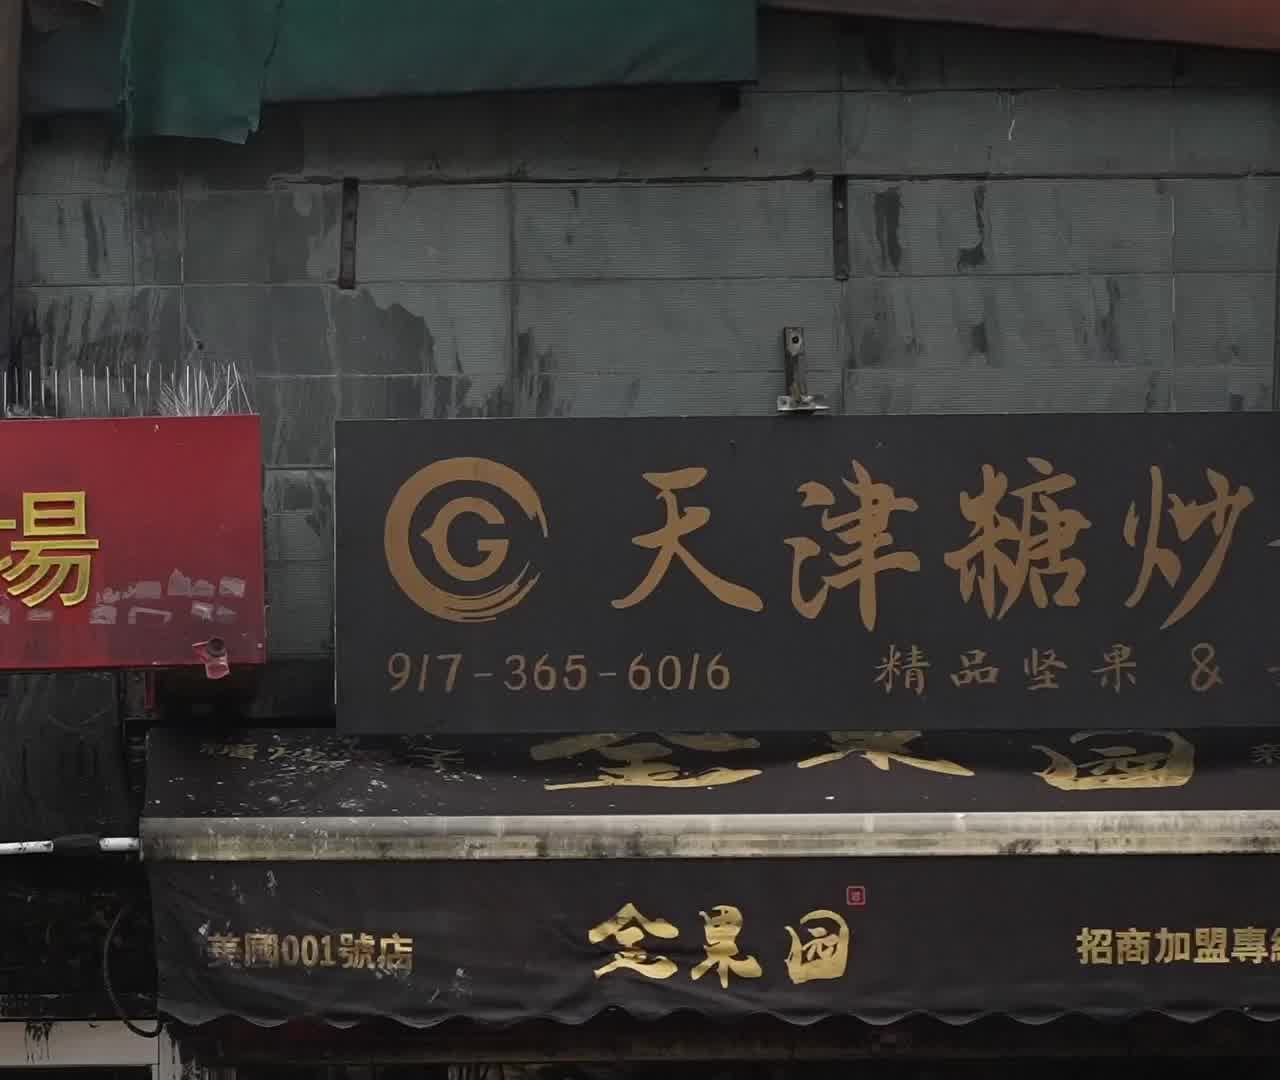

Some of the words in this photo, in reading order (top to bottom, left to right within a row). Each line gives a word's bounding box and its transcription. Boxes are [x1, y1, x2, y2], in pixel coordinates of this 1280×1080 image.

[611, 457, 1280, 632] 天津糖炒
[874, 643, 1138, 694] 精品坚果
[1190, 642, 1224, 692] &
